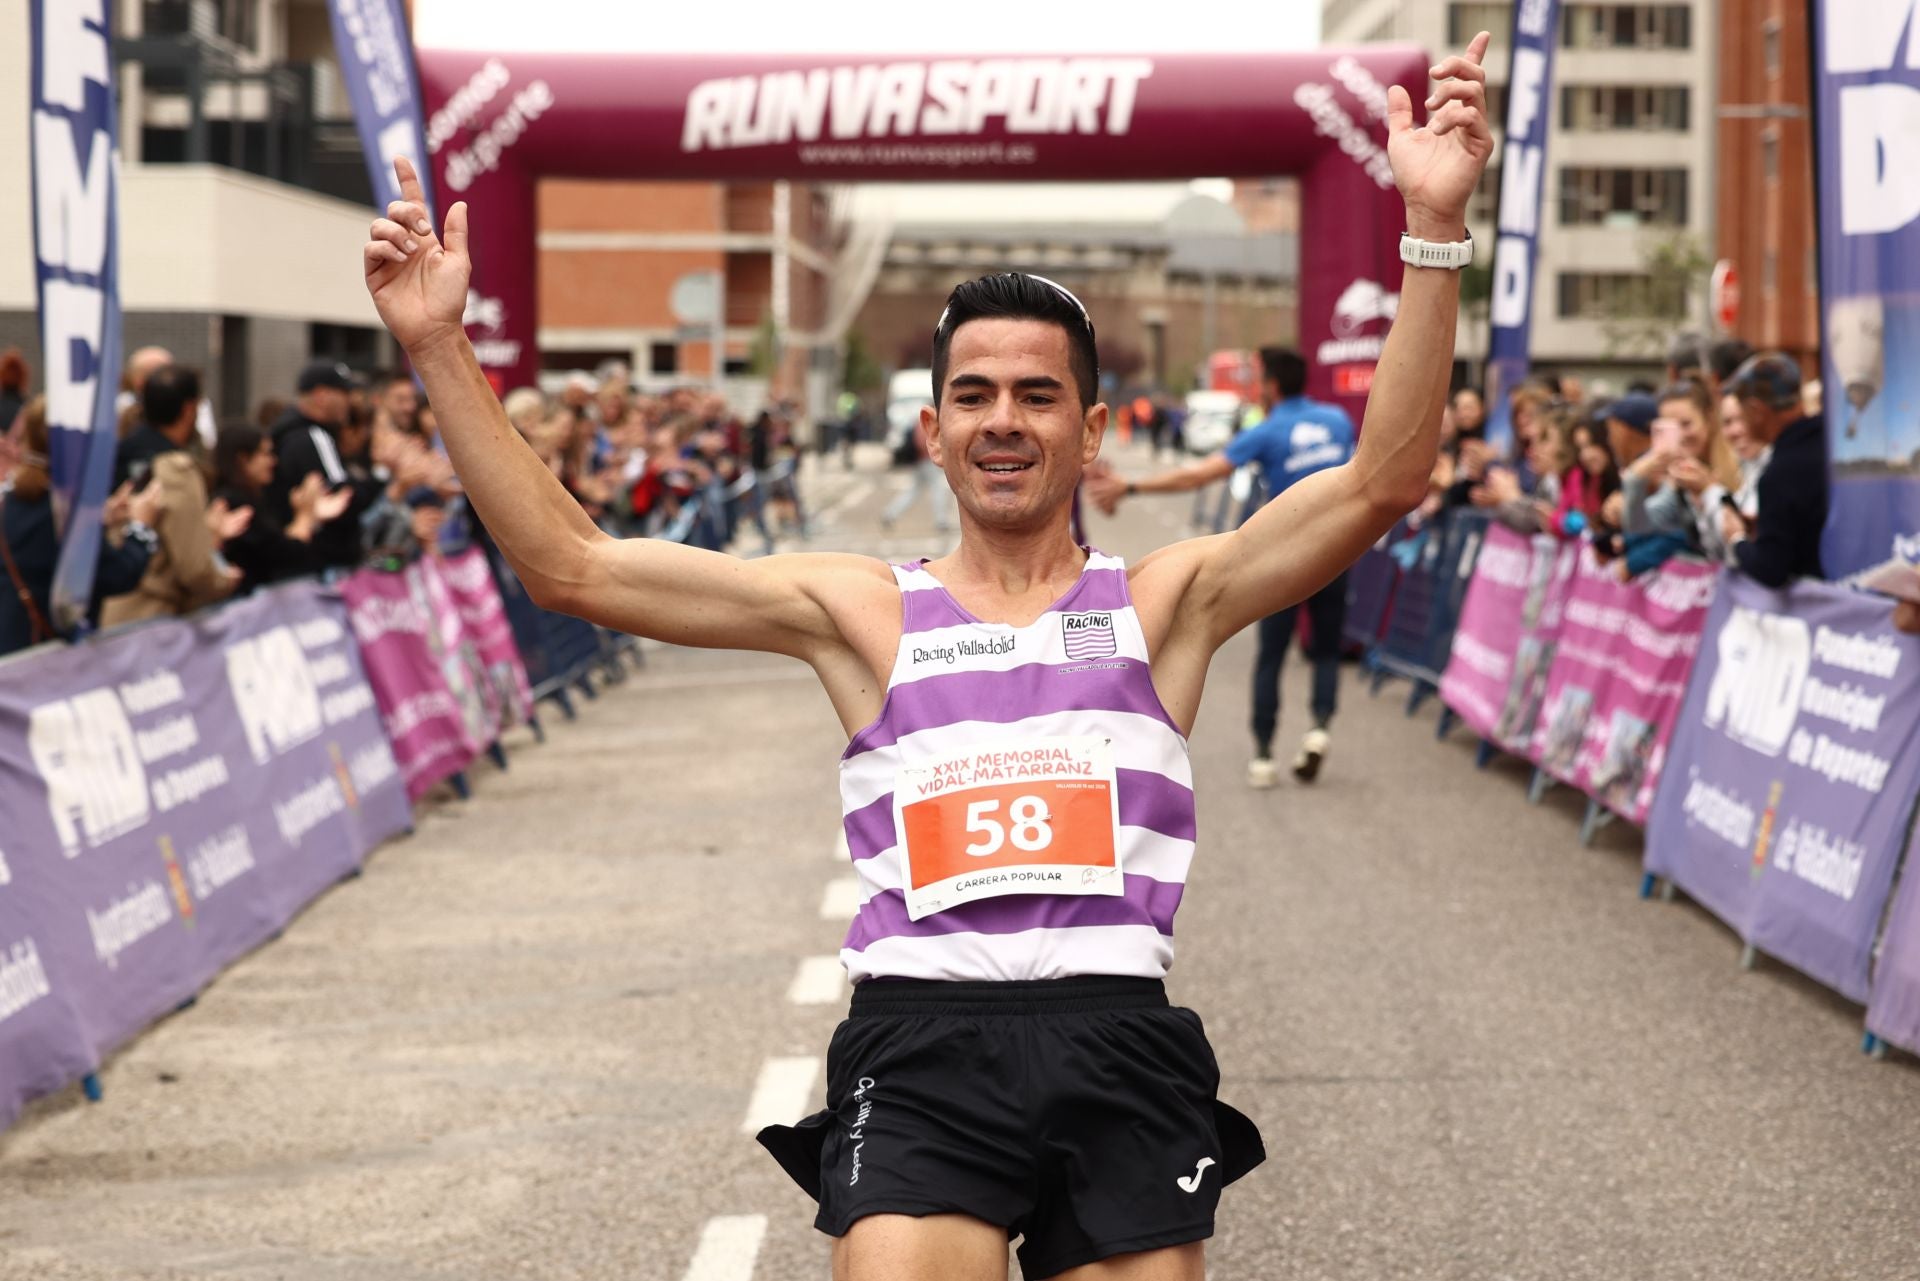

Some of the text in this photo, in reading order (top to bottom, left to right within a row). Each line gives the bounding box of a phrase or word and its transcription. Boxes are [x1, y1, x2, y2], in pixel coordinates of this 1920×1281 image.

[1066, 615, 1109, 629] RACING
[912, 634, 1016, 664] Racing Valladolid
[917, 761, 1093, 795] VIDAL-MATARRANZ
[931, 748, 1073, 778] XXIX MEMORIAL
[965, 795, 1053, 857] 58
[956, 871, 1062, 892] CARRERA POPULAR
[849, 1128, 863, 1139] y
